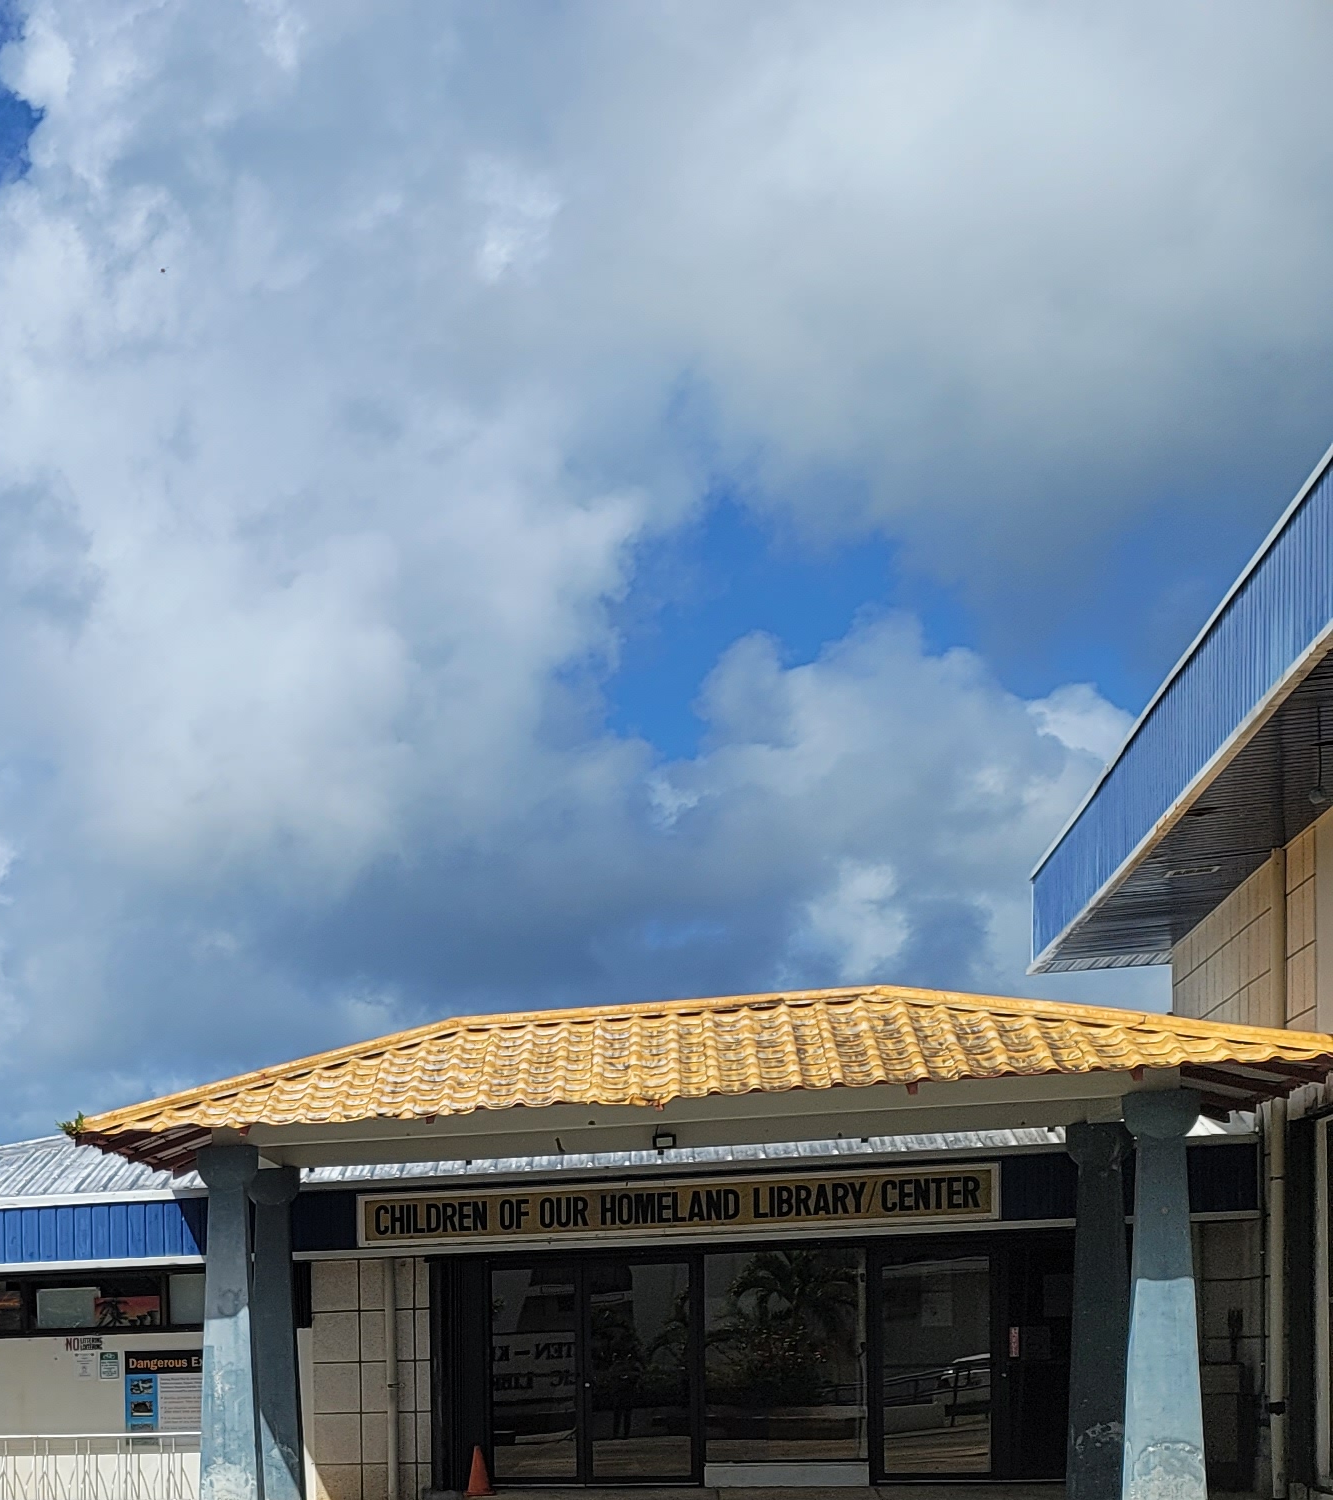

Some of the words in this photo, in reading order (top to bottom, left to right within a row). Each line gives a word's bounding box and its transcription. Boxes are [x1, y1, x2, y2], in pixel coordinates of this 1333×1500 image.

[374, 1200, 487, 1236] CHILDREN
[499, 1199, 530, 1231] OF
[539, 1196, 589, 1229] OUR
[600, 1188, 741, 1226] HOMELAND
[65, 1337, 80, 1351] NO
[128, 1358, 188, 1371] Dangerous
